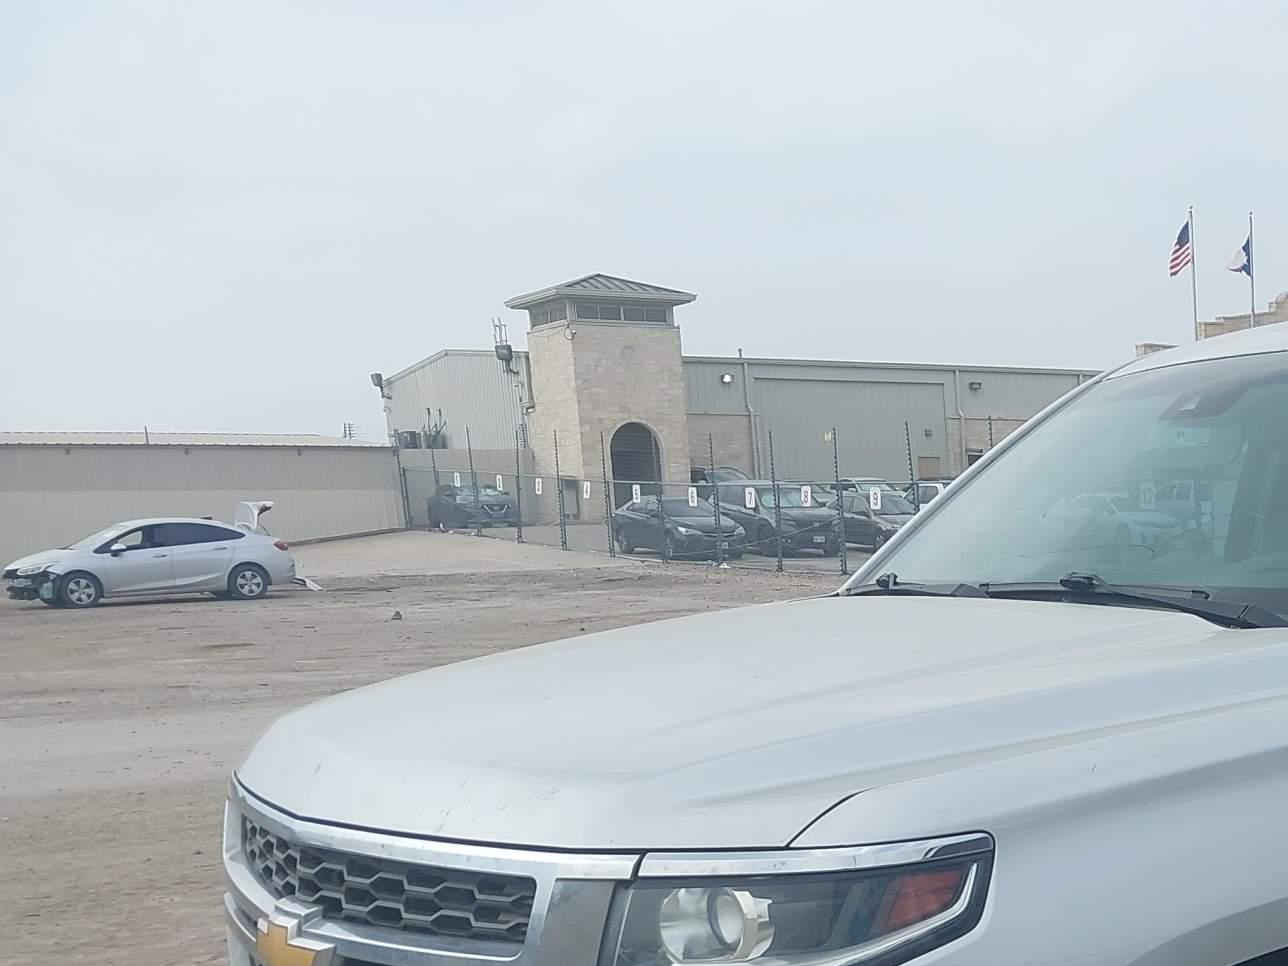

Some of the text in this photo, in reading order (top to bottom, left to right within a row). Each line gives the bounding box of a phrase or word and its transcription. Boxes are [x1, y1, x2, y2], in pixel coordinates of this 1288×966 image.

[747, 491, 753, 505] 7
[803, 490, 809, 503] 8
[872, 492, 879, 506] 9
